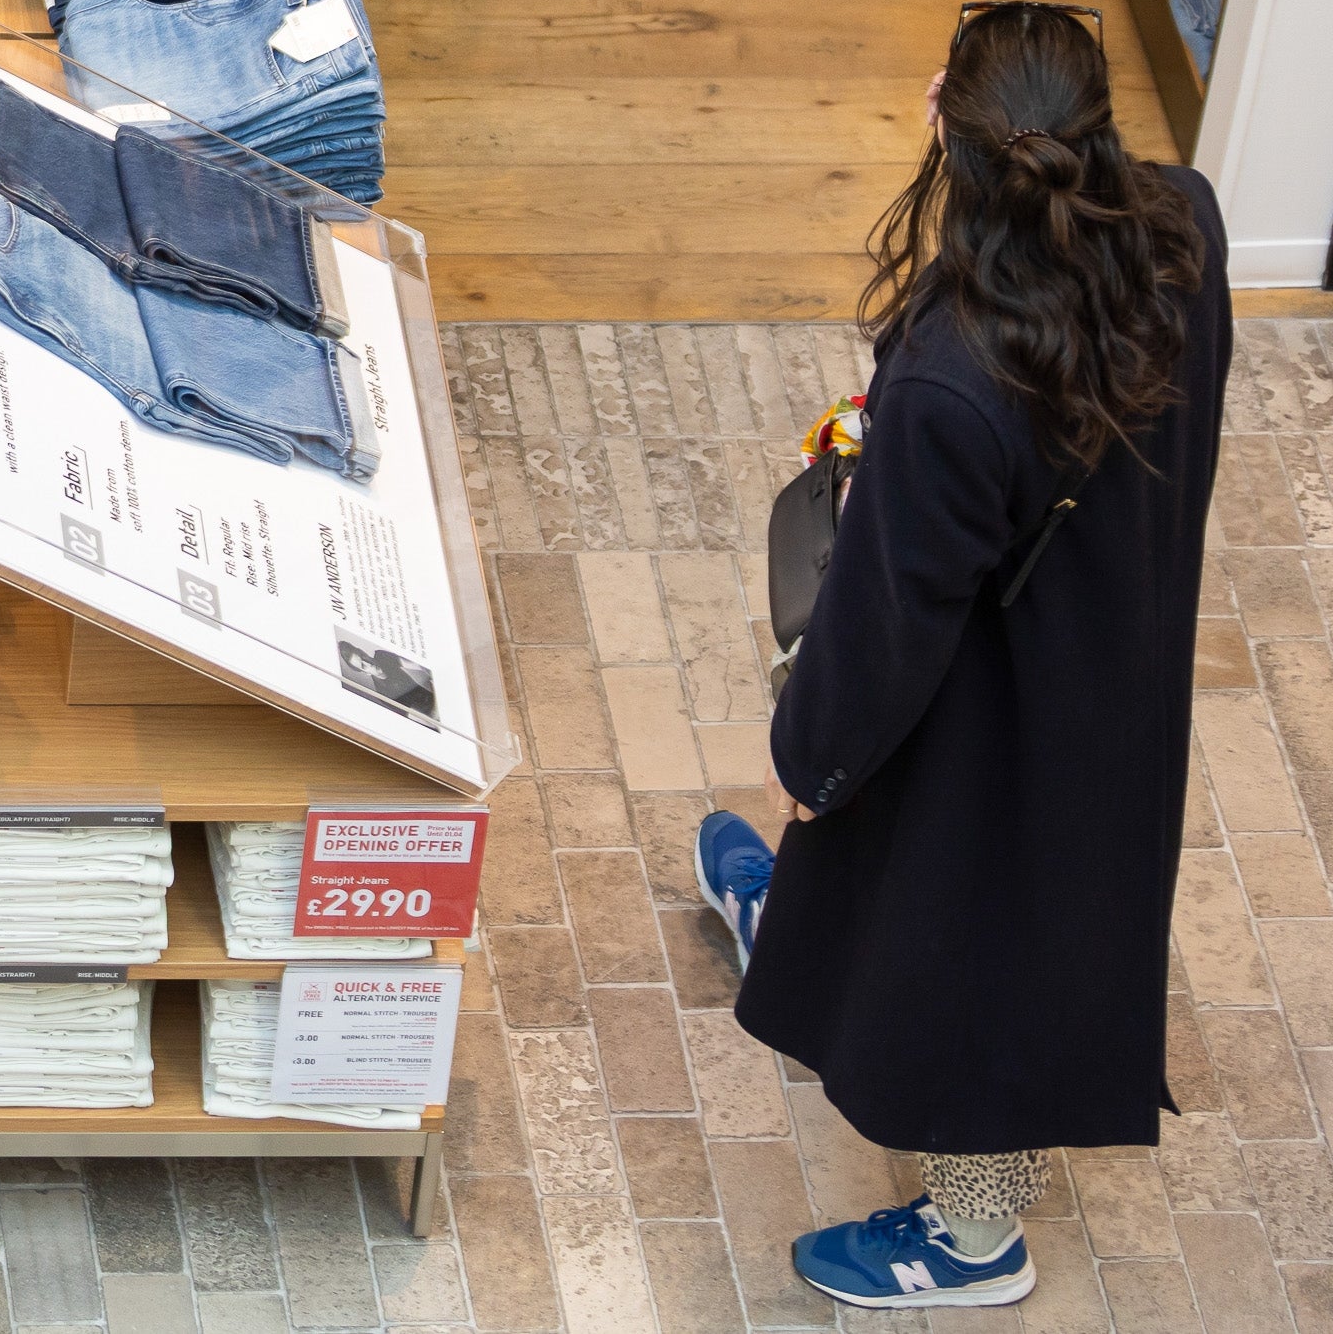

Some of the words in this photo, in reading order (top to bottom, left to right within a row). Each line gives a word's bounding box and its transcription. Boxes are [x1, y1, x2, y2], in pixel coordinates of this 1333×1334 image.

[365, 343, 380, 381] Jeans
[0, 383, 12, 412] waist
[368, 380, 389, 433] Straight
[2, 412, 15, 441] clean
[117, 419, 133, 452] denim.
[5, 455, 19, 474] with
[61, 451, 85, 505] Fabric
[122, 453, 138, 487] cotton
[105, 468, 118, 493] from
[108, 495, 123, 524] Made
[125, 487, 142, 511] 100%
[130, 512, 143, 534] soft
[175, 507, 200, 560] Detail
[239, 521, 252, 541] rise
[253, 499, 271, 541] Straight
[68, 525, 99, 562] 02
[219, 516, 236, 558] Regular
[241, 540, 255, 562] Mid
[224, 560, 238, 578] Fit:
[260, 543, 280, 598] Silhouette:
[318, 522, 344, 596] ANDERSON
[246, 563, 259, 588] Rise:
[184, 580, 216, 616] 03
[330, 594, 347, 620] JW
[325, 825, 420, 837] EXCLUSIVE
[323, 840, 399, 852] OPENING
[405, 840, 463, 852] OFFER
[310, 875, 355, 887] Straight
[356, 876, 390, 885] Jeans
[306, 888, 432, 918] £29.90
[334, 982, 381, 994] QUICK
[385, 982, 396, 993] &
[401, 982, 443, 993] FREE
[400, 995, 441, 1003] SERVICE
[298, 1010, 324, 1018] FREE
[890, 1261, 938, 1293] N
